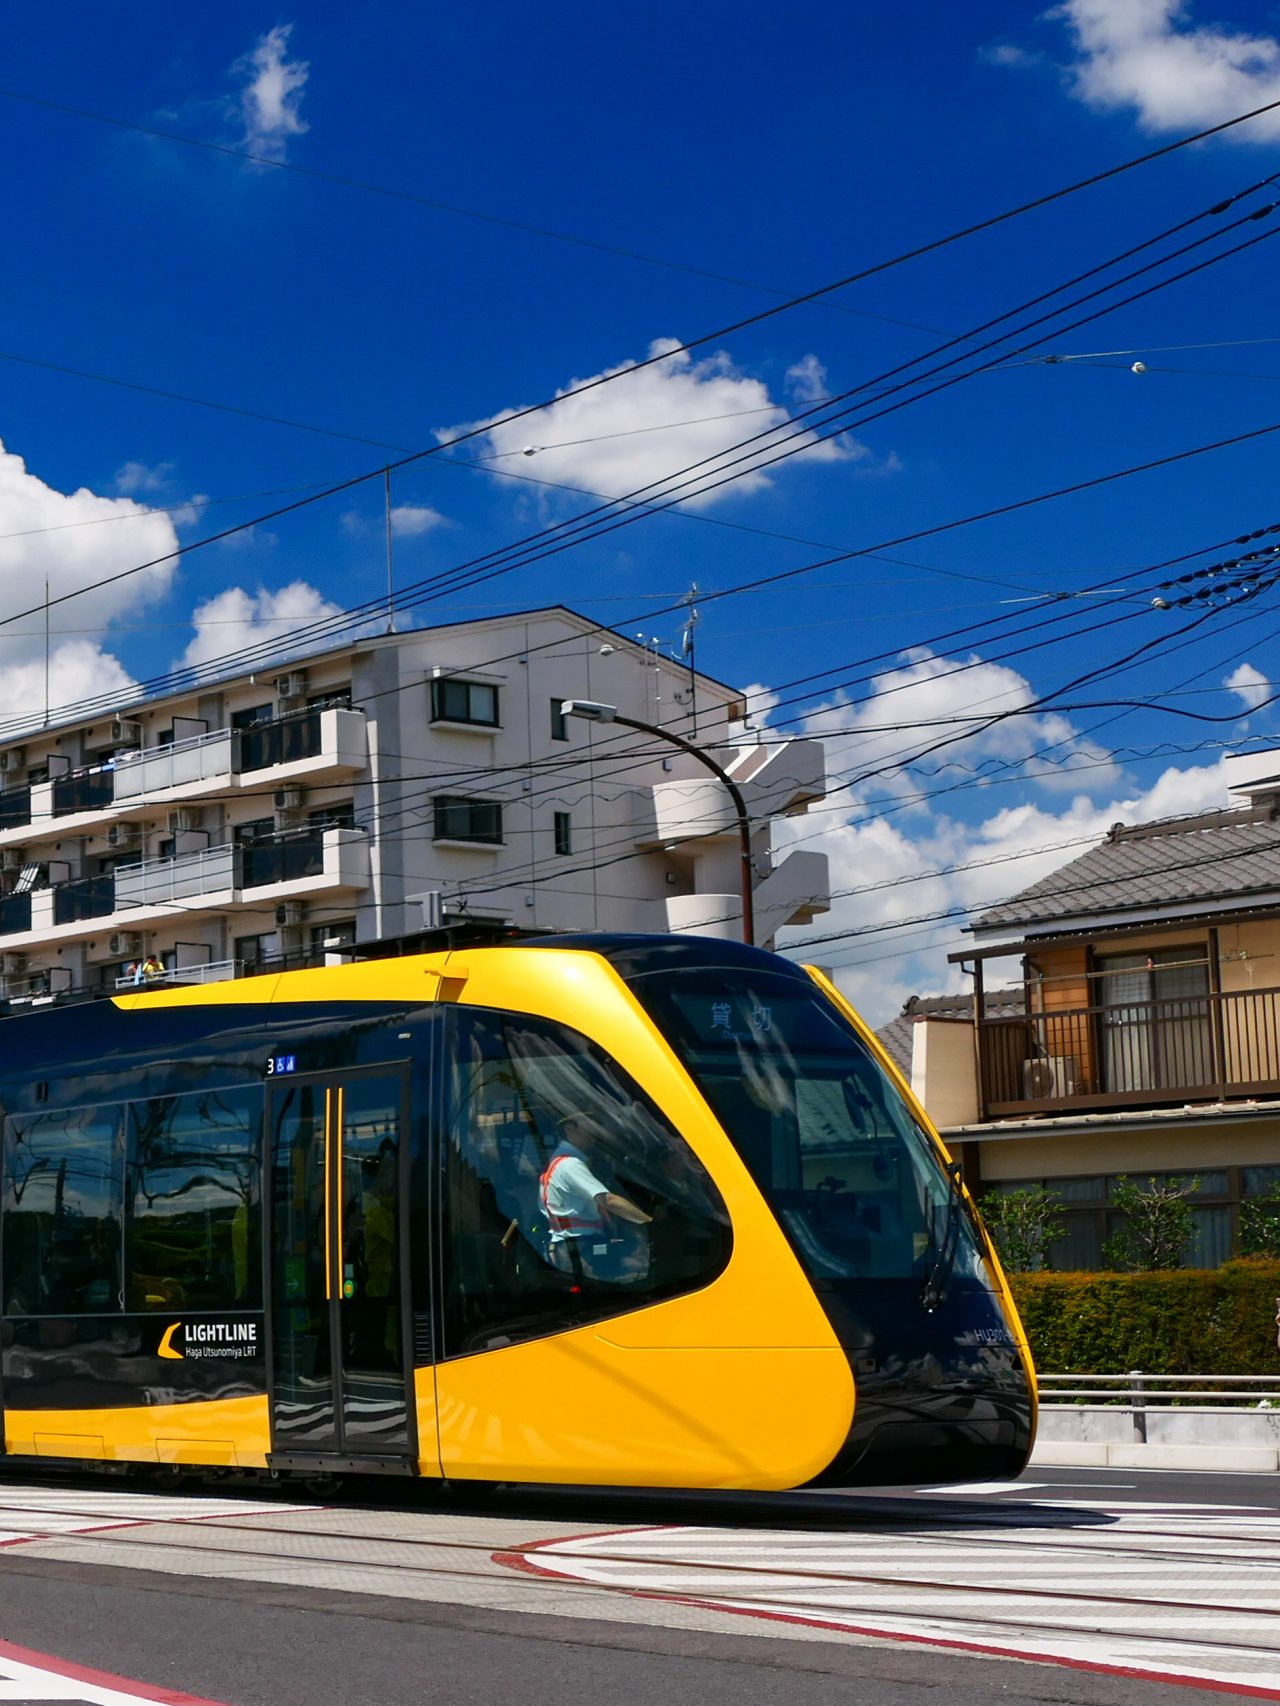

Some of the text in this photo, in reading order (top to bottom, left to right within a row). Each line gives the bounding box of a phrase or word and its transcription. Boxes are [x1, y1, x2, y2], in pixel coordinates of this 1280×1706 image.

[267, 1058, 274, 1074] 3
[185, 1324, 257, 1341] LIGHTLINE
[185, 1346, 257, 1359] Haga Utsunomiya LRT
